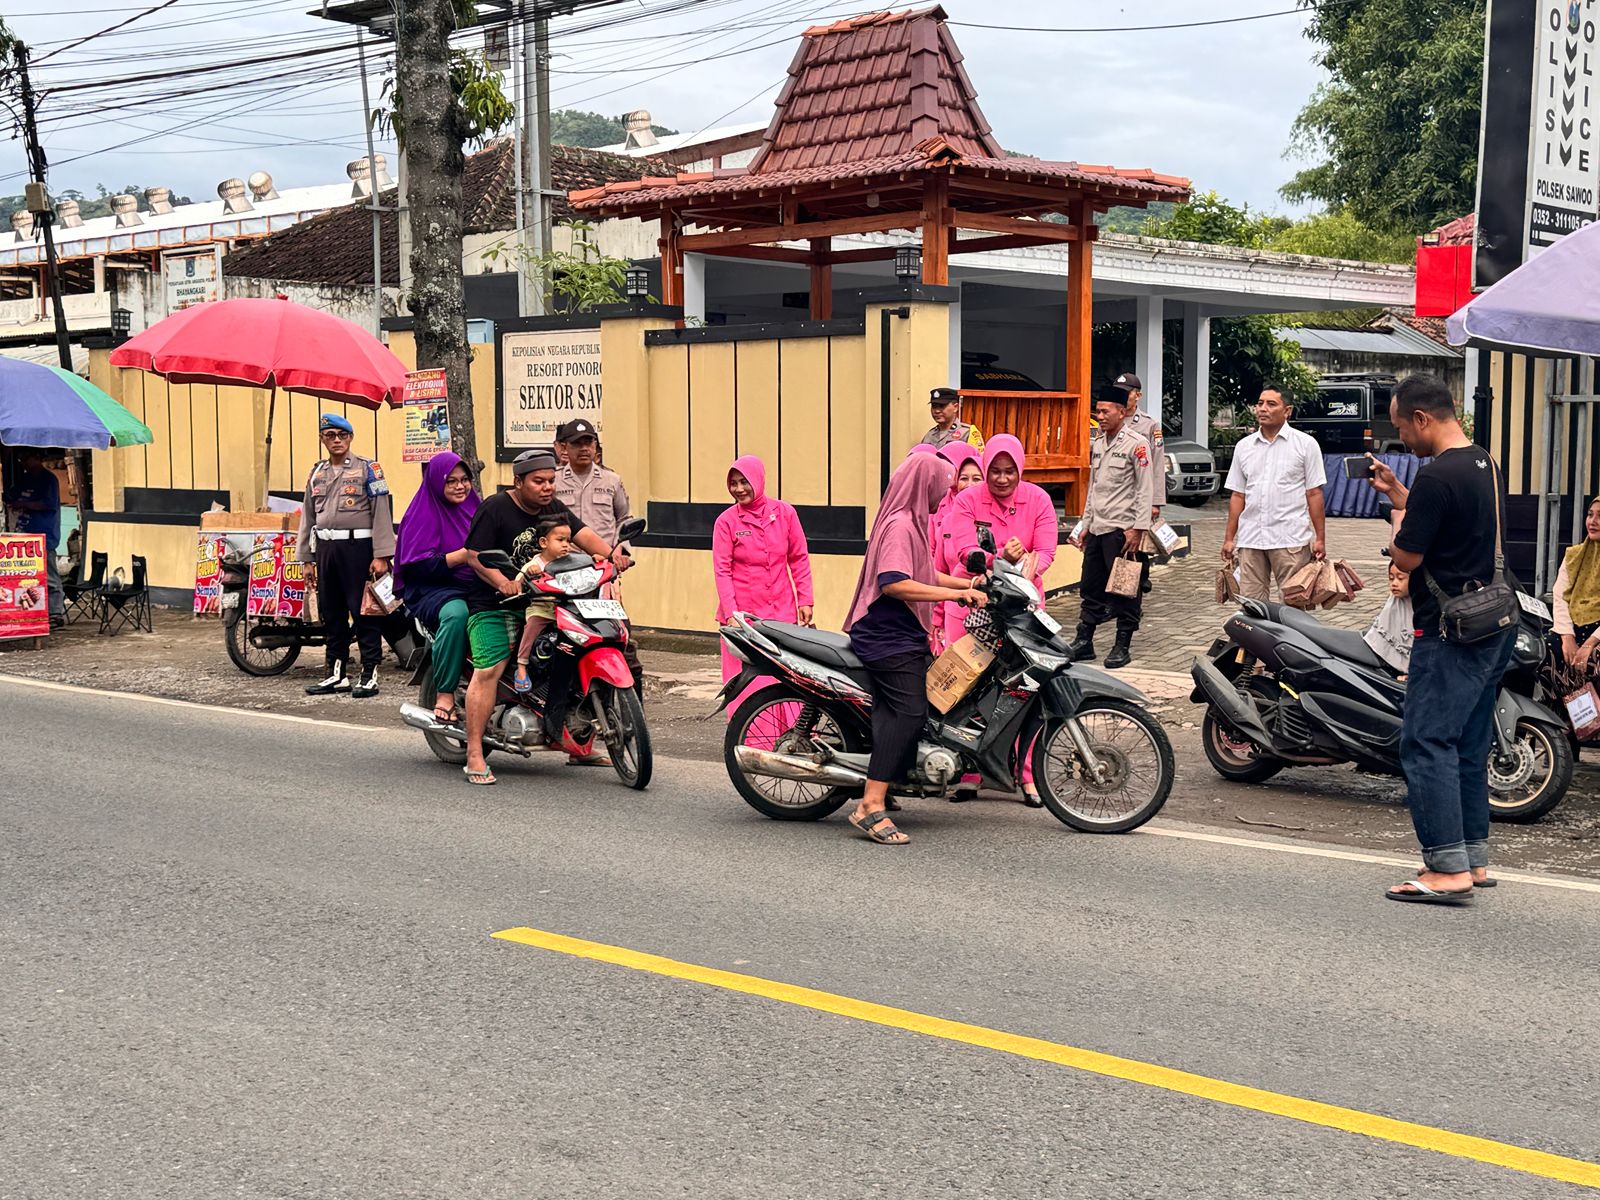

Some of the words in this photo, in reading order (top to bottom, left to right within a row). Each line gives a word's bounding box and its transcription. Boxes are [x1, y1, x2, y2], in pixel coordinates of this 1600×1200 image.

[1537, 179, 1564, 200] POLSEK
[1566, 185, 1592, 205] SAWOO
[1533, 208, 1549, 226] 0352
[1555, 212, 1580, 230] 311105
[512, 346, 546, 357] KEPOLISIAN
[547, 344, 571, 356] NEGARA
[571, 343, 601, 355] REPUBLIK
[527, 362, 563, 378] RESORT
[565, 361, 602, 377] PONOR
[405, 379, 445, 391] ELEKTRONIK
[416, 388, 442, 397] LISTRIK
[519, 384, 574, 410] SEKTOR
[510, 420, 524, 432] Jalan
[525, 420, 541, 432] Sunan
[198, 560, 218, 577] GULUNG
[253, 561, 275, 578] GULUNG
[196, 583, 219, 597] Sempol
[251, 584, 277, 598] Sempol
